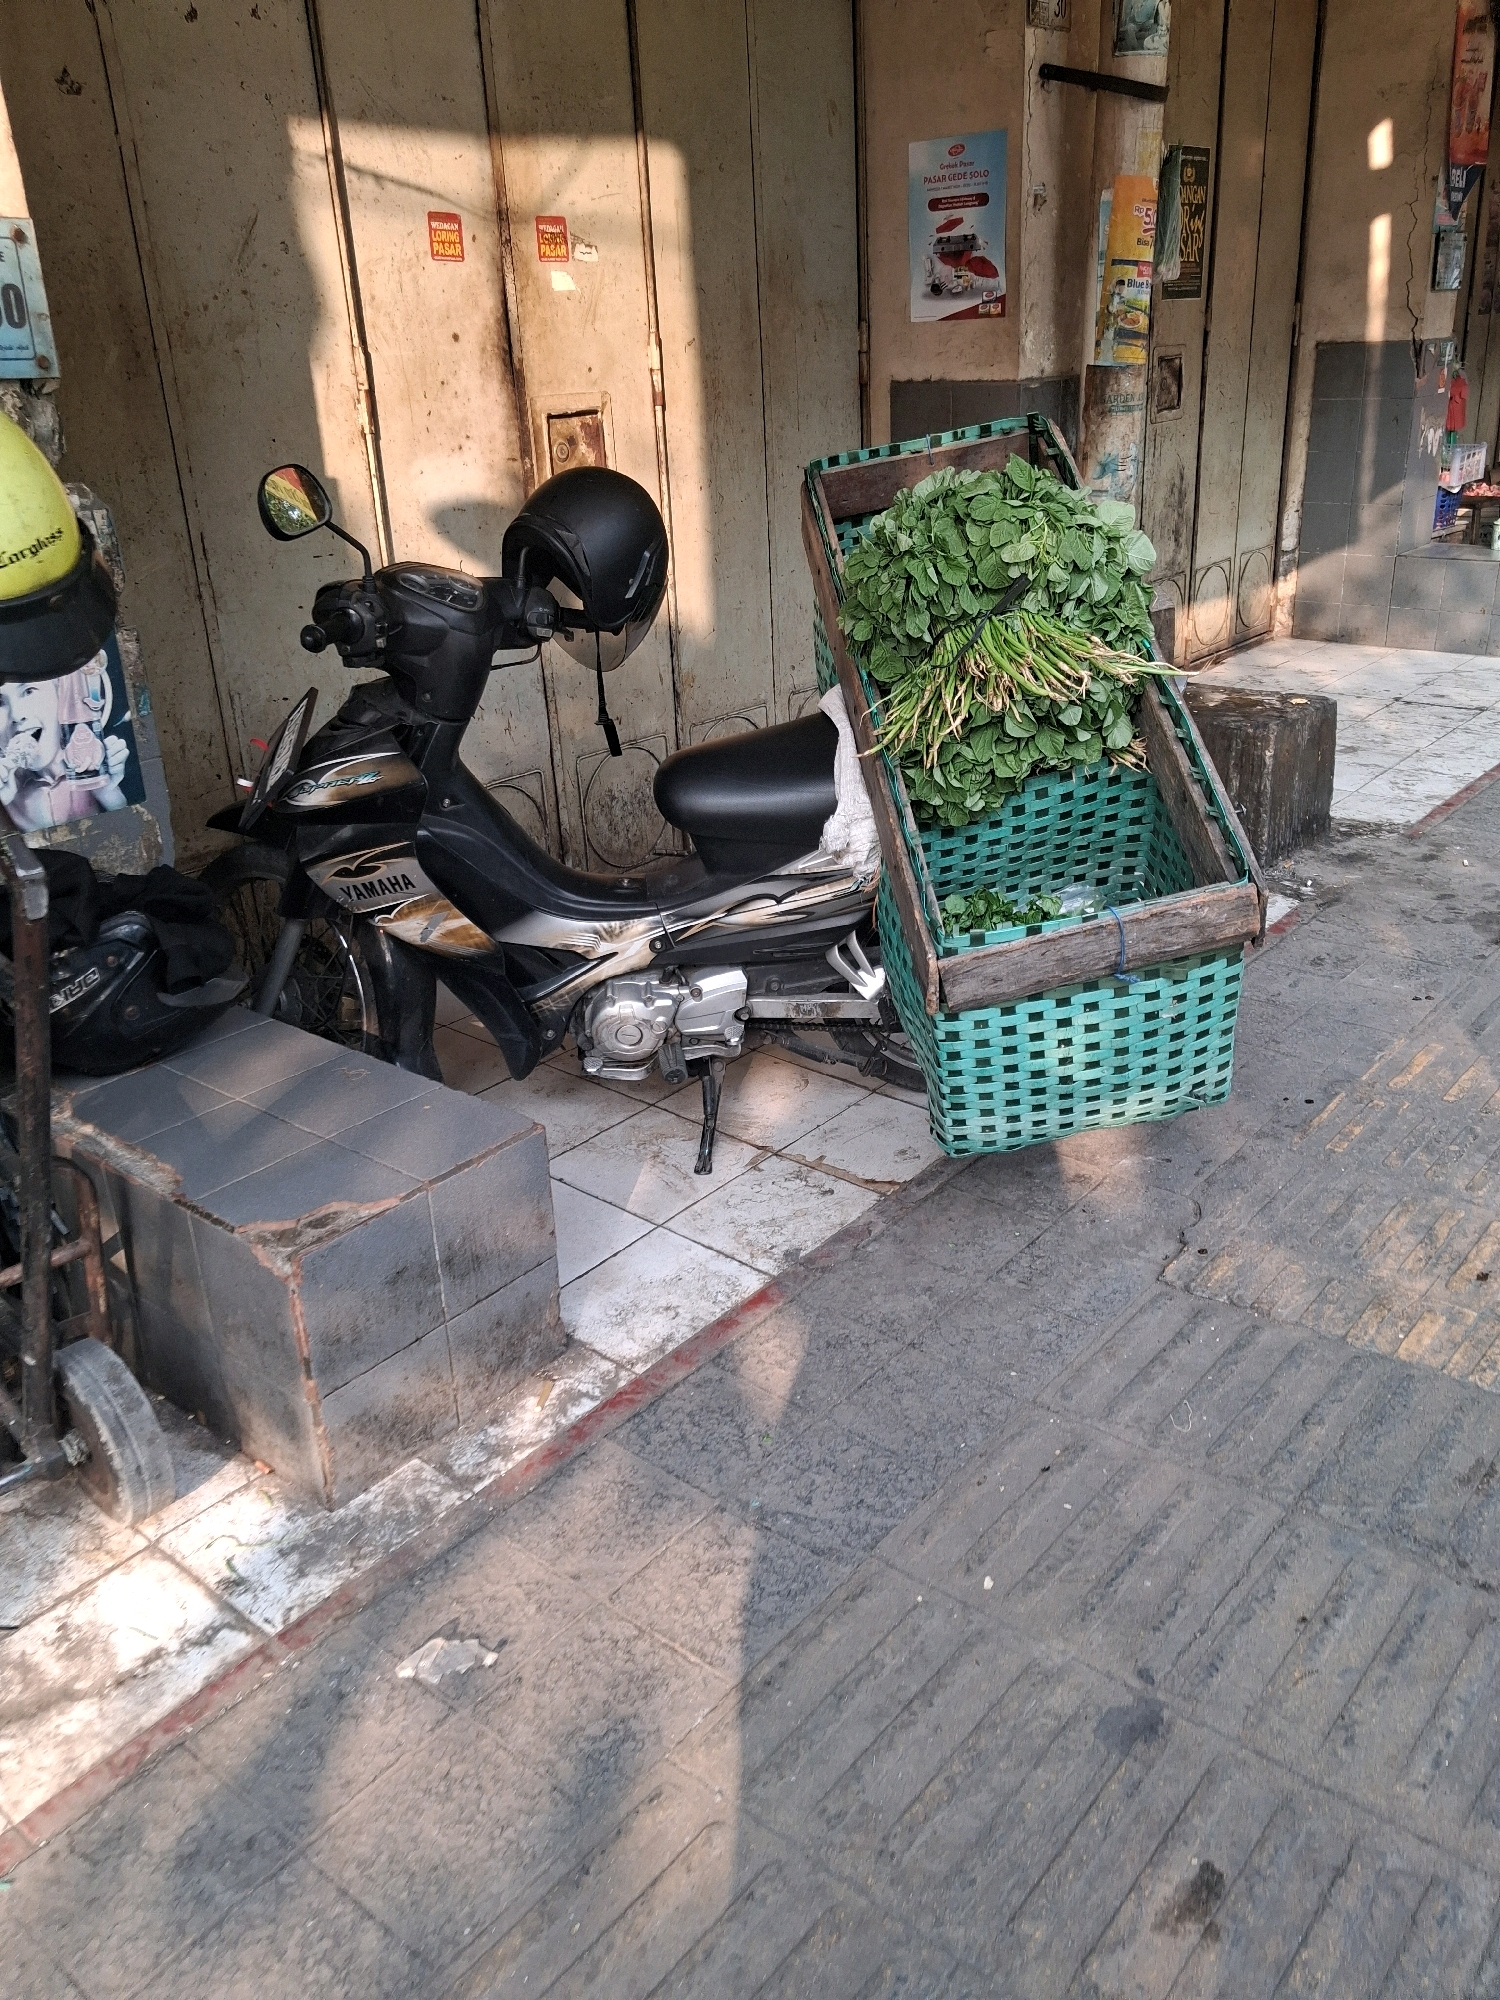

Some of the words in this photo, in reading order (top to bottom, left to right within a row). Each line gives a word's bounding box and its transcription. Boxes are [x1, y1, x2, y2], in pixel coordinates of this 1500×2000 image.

[923, 174, 947, 185] PASAR
[948, 171, 968, 182] GEDE
[969, 169, 990, 179] SOLO
[431, 230, 460, 243] LORING
[432, 242, 463, 257] PASAR
[540, 244, 567, 257] PASAR
[1127, 279, 1144, 289] Blue
[0, 283, 27, 329] 0
[339, 873, 417, 901] YAMAHA
